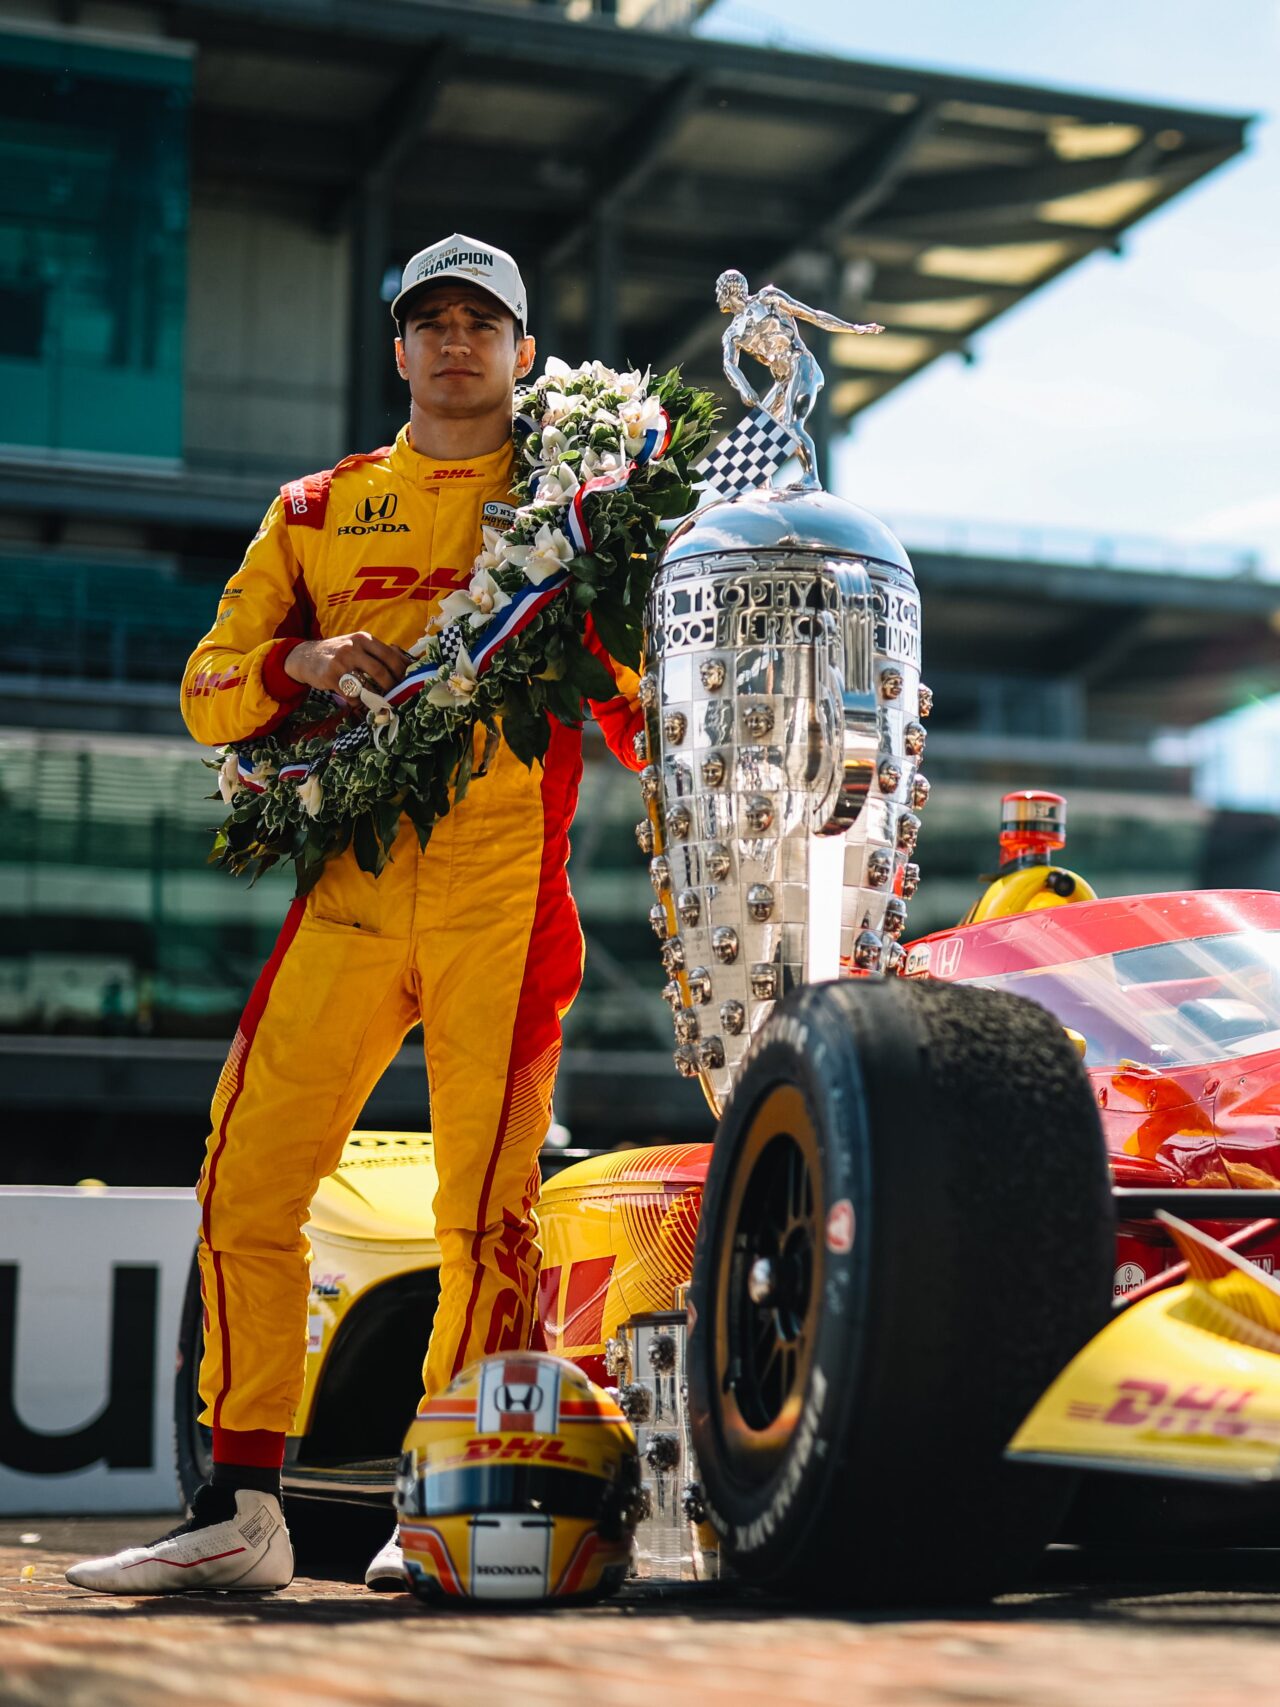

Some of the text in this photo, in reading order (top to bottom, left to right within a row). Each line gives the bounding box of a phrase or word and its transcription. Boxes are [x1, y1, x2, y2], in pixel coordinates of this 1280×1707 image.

[439, 246, 458, 260] 500
[416, 252, 494, 281] CHAMPION
[432, 468, 477, 480] DHL
[337, 522, 411, 537] HONDA
[351, 566, 474, 601] DH
[1104, 1379, 1257, 1437] DHL
[462, 1437, 571, 1462] DHL
[475, 1565, 543, 1577] HONDA
